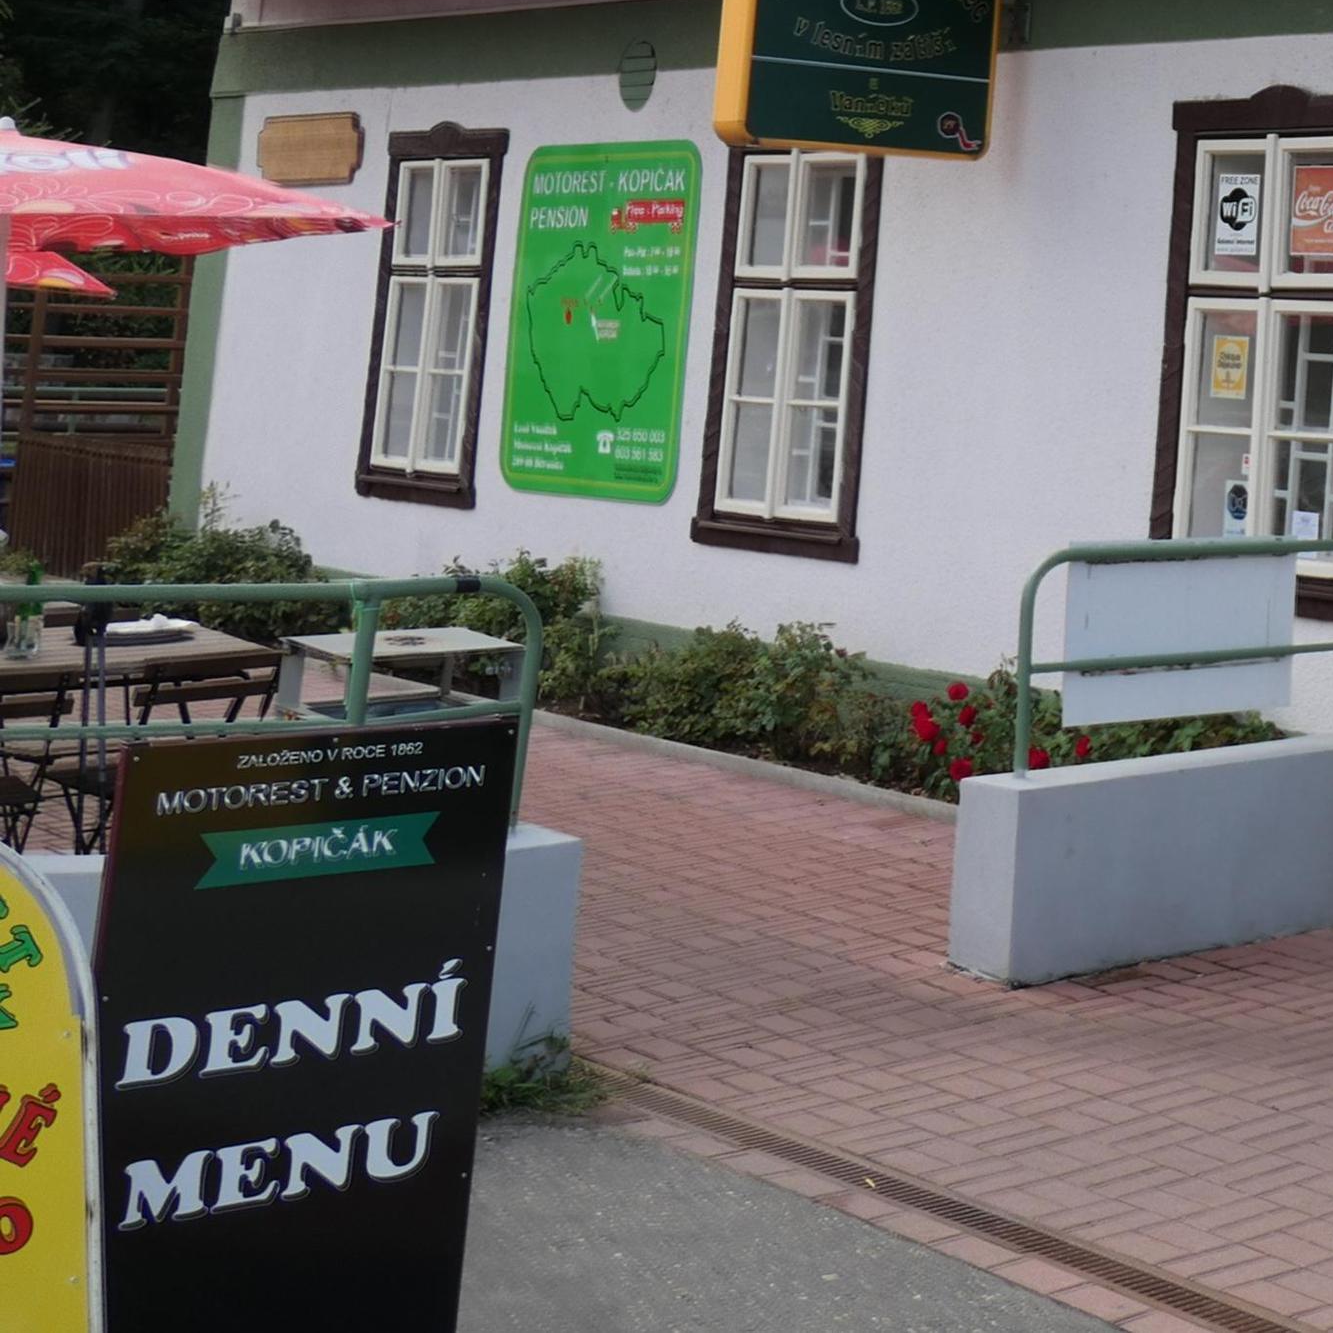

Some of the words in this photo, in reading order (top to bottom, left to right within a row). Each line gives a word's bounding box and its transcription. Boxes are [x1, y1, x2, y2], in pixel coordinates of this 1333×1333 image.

[533, 169, 606, 195] MOTOREST
[1220, 175, 1239, 185] FREE
[1240, 176, 1259, 186] ZONE
[530, 205, 589, 230] PENSION
[237, 749, 323, 769] ZALOŽENO
[326, 747, 341, 763] V
[342, 744, 386, 762] ROCE
[390, 742, 423, 756] 1862
[156, 778, 329, 816] MOTOREST
[334, 776, 354, 800] &
[362, 765, 486, 797] PENZION
[239, 824, 398, 870] KOPIČÁK
[114, 958, 468, 1091] DENNÍ
[117, 1110, 440, 1231] MENU
